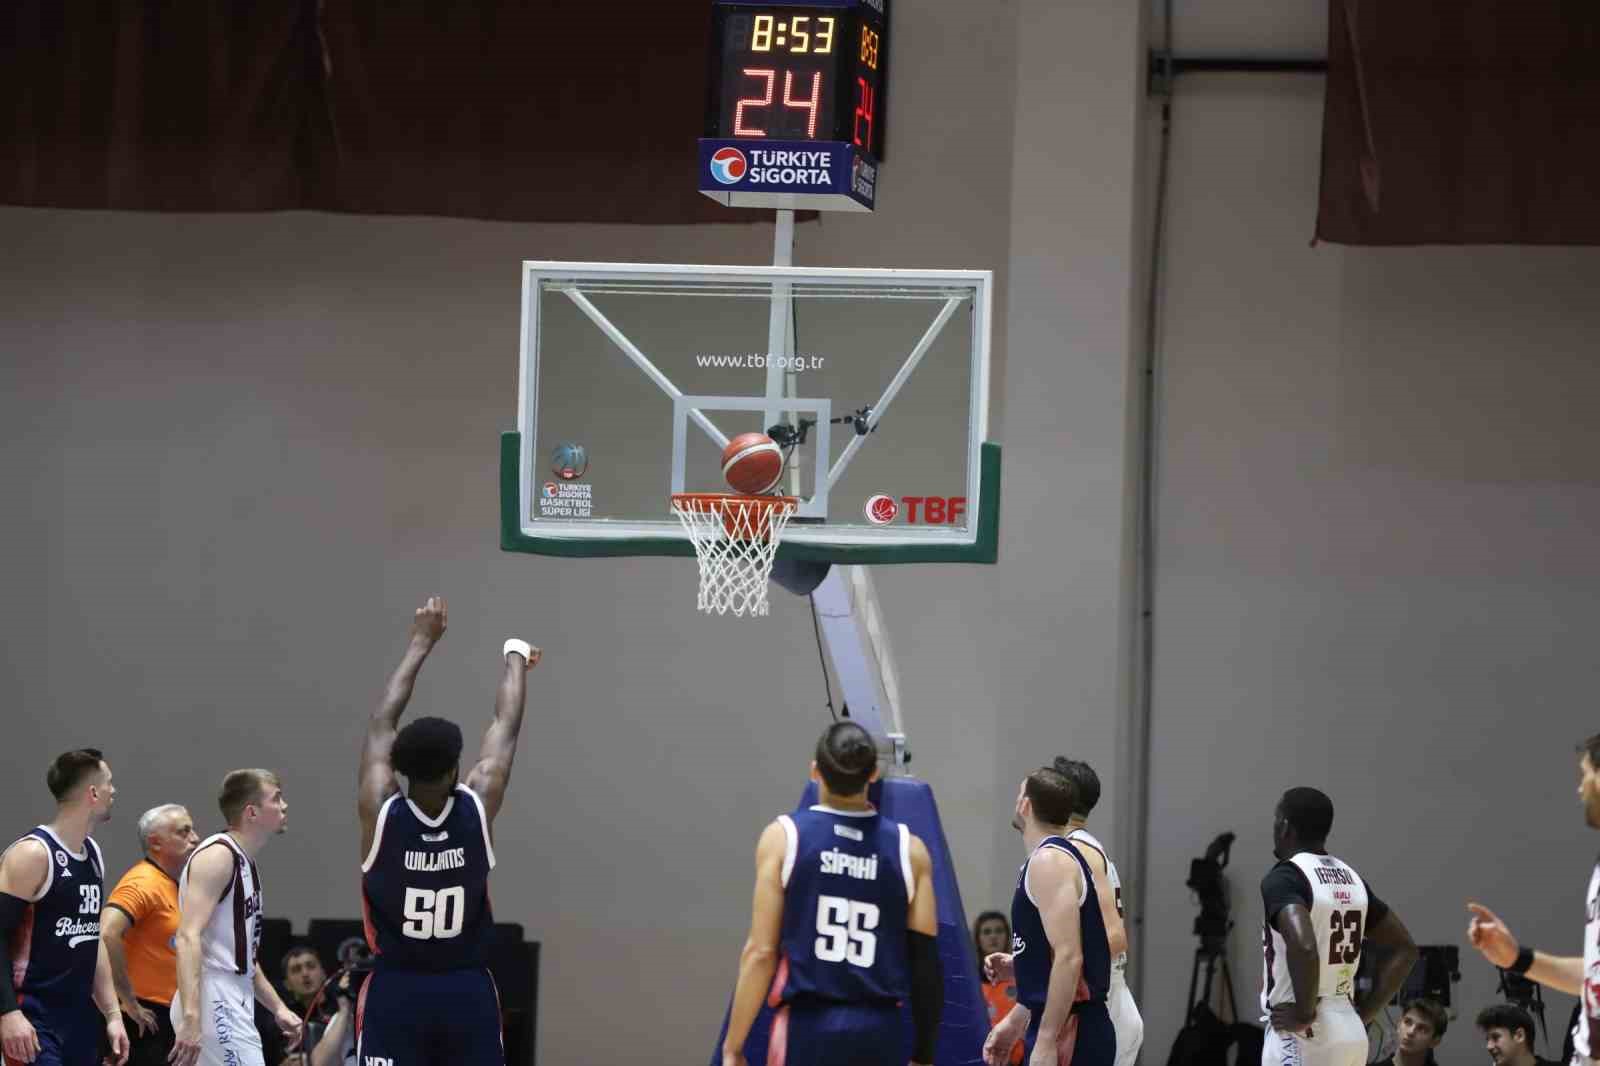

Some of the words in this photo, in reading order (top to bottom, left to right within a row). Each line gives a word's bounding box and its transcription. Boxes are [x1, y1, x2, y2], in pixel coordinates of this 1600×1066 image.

[752, 15, 835, 53] 8:53
[734, 69, 821, 138] 24
[696, 353, 824, 371] www.tbf.org.tr
[540, 498, 592, 508] BASKETBOL
[902, 496, 966, 524] TBF
[79, 884, 100, 914] 38
[402, 886, 465, 940] 50
[815, 894, 880, 968] 55
[1328, 910, 1361, 964] 23
